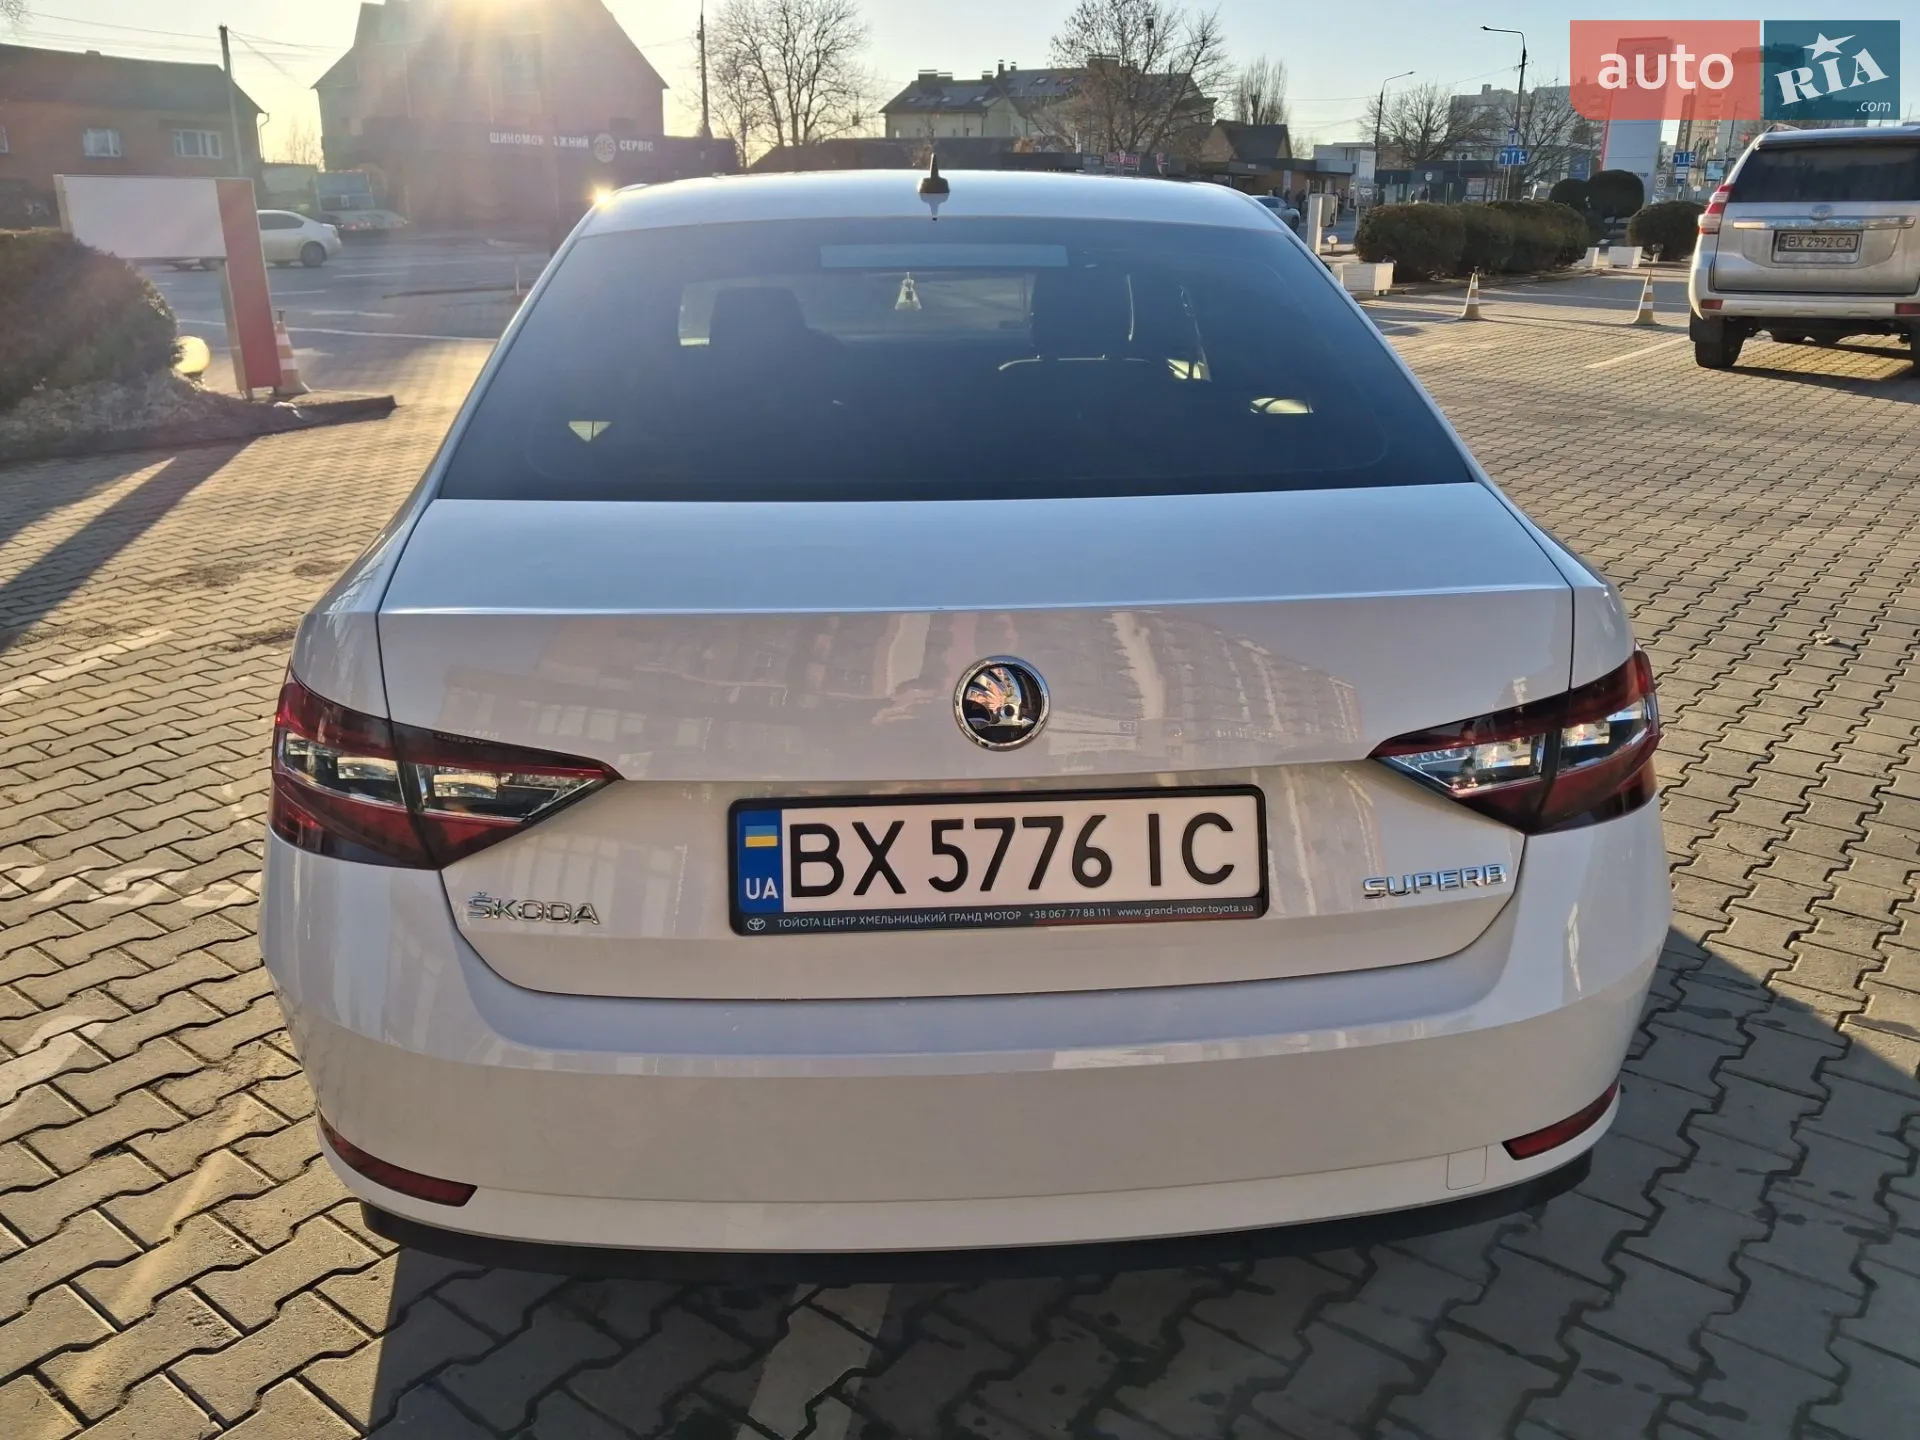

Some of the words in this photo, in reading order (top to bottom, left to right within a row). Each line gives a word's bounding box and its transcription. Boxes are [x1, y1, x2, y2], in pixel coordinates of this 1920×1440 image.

[619, 139, 654, 152] СЕРВІС
[1806, 237, 1833, 248] 2992
[790, 821, 907, 898] BX
[928, 814, 1112, 892] 5776
[745, 877, 779, 900] UA
[1363, 863, 1506, 899] SUPERB
[467, 892, 600, 925] ŠKODA
[777, 917, 820, 929] ТОЙОТА
[823, 917, 857, 928] ЦЕНТР
[859, 913, 947, 926] ХМЕЛЬНИЦЬКИЙ
[949, 913, 982, 923] ГРАНД
[984, 911, 1021, 922] МОТОР
[1029, 911, 1046, 919] +38
[1049, 910, 1066, 918] 067
[1069, 909, 1081, 918] 77
[1083, 909, 1095, 917] 88
[1098, 908, 1111, 917] 111
[1117, 903, 1254, 918] www.grand-motor.toyota.ua
